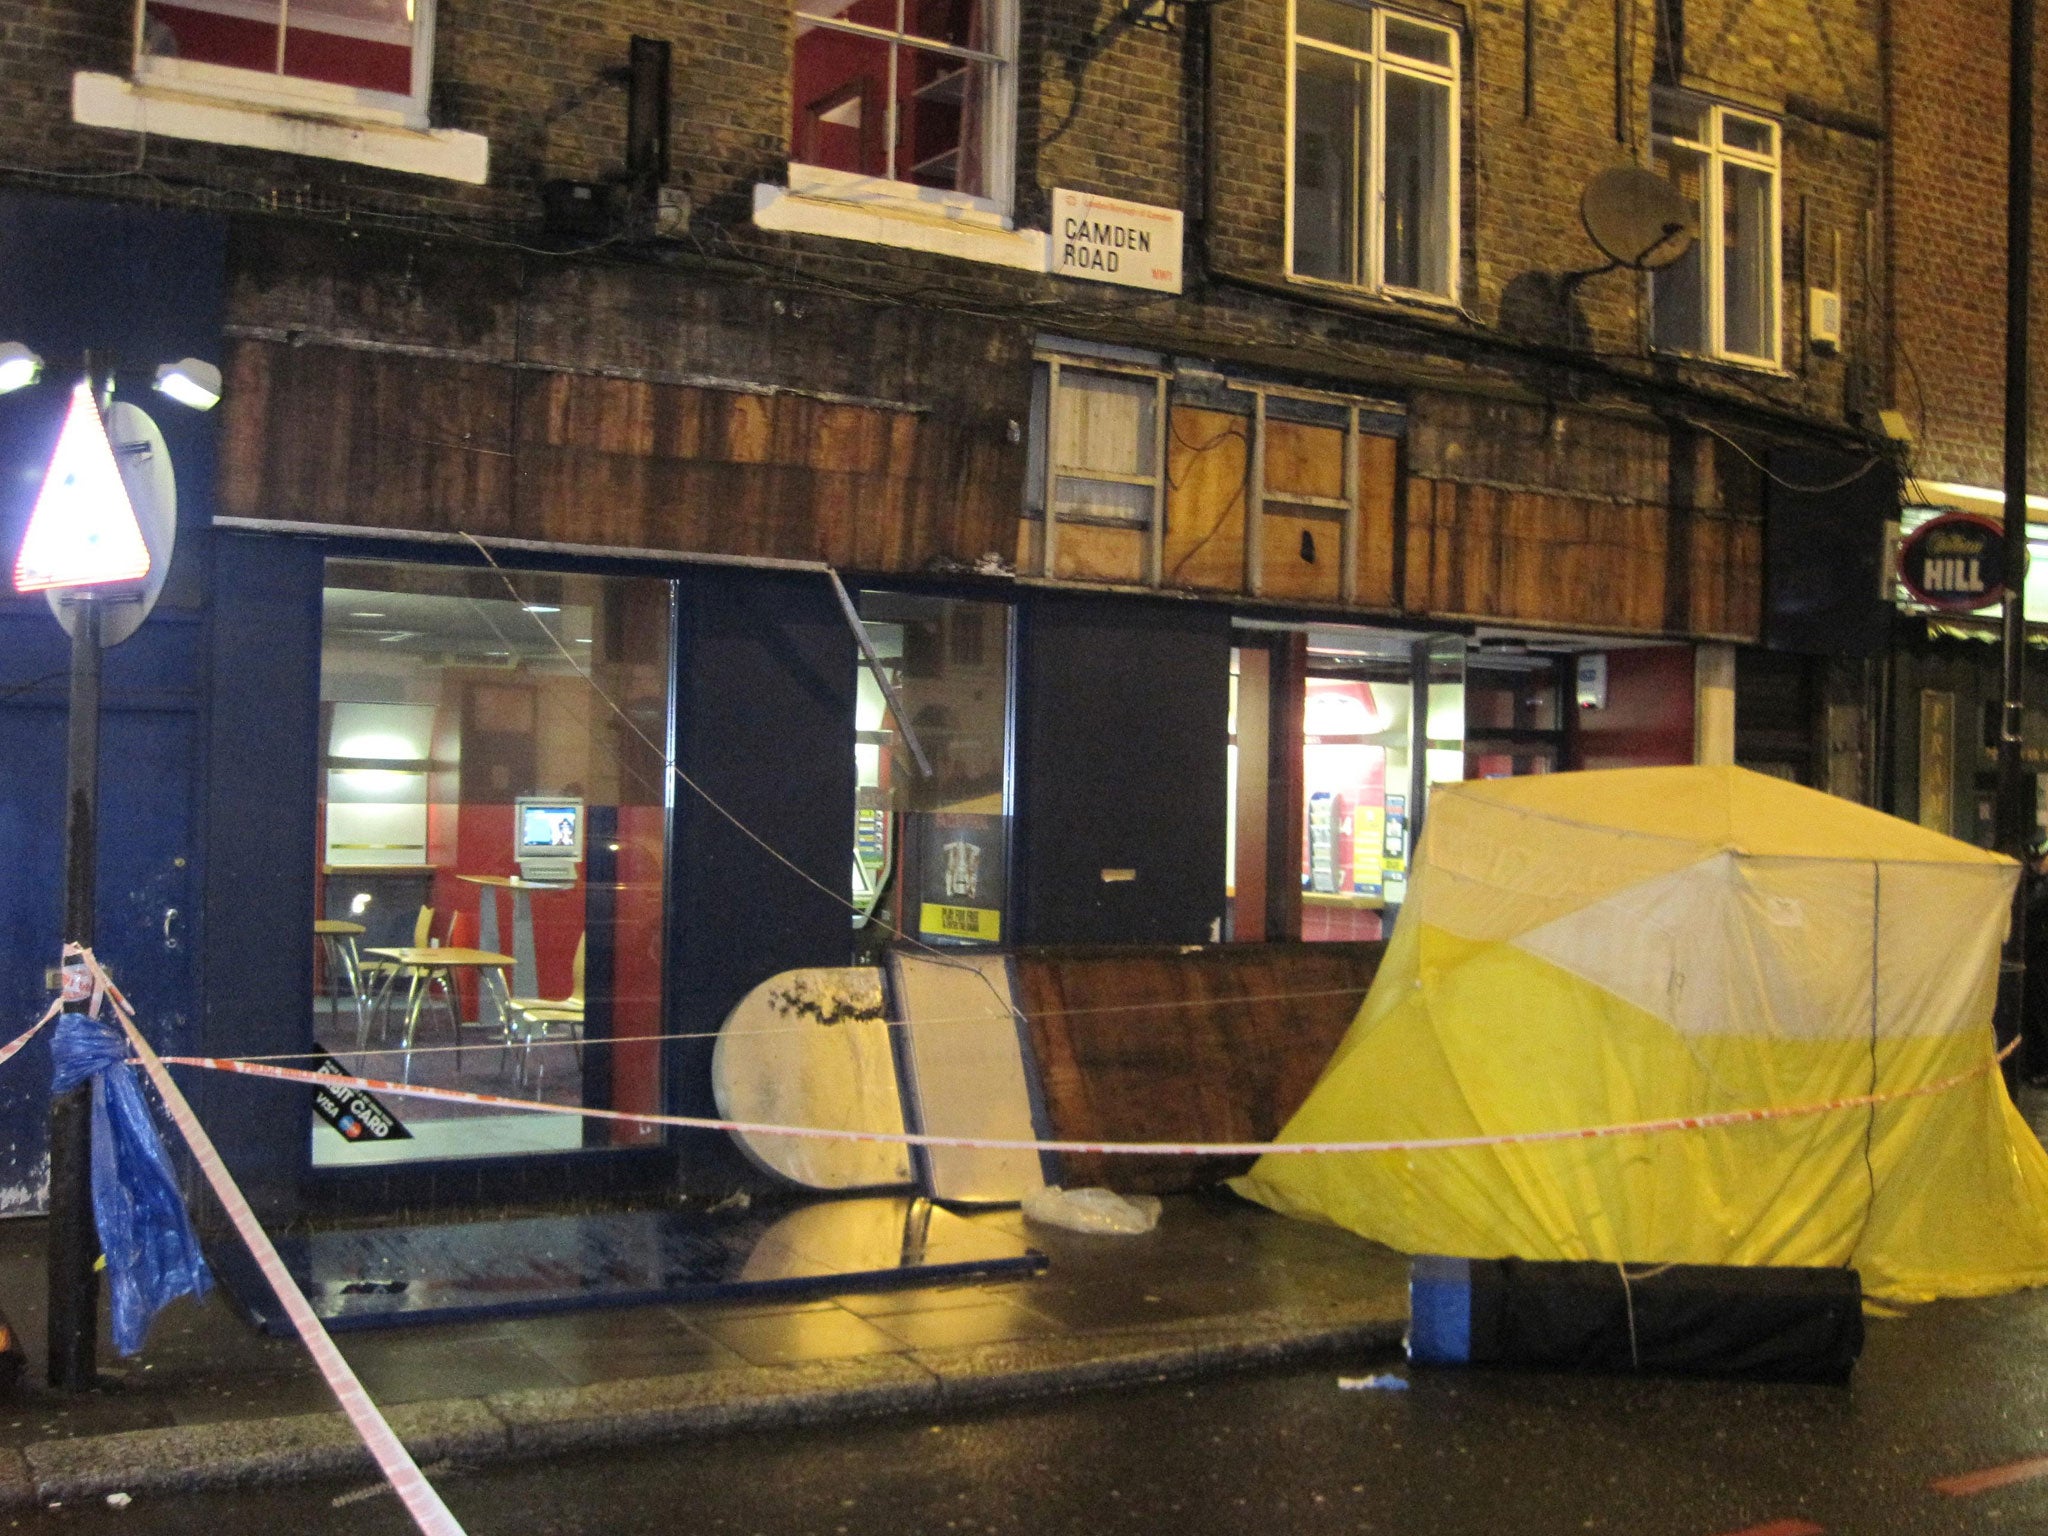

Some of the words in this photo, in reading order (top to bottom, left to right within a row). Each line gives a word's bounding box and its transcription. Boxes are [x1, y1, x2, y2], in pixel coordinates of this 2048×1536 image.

[1065, 217, 1150, 253] CAMDEN
[1063, 243, 1119, 273] ROAD
[1923, 559, 1985, 592] HILL
[316, 1091, 340, 1118] VISA
[350, 1099, 389, 1138] CARD
